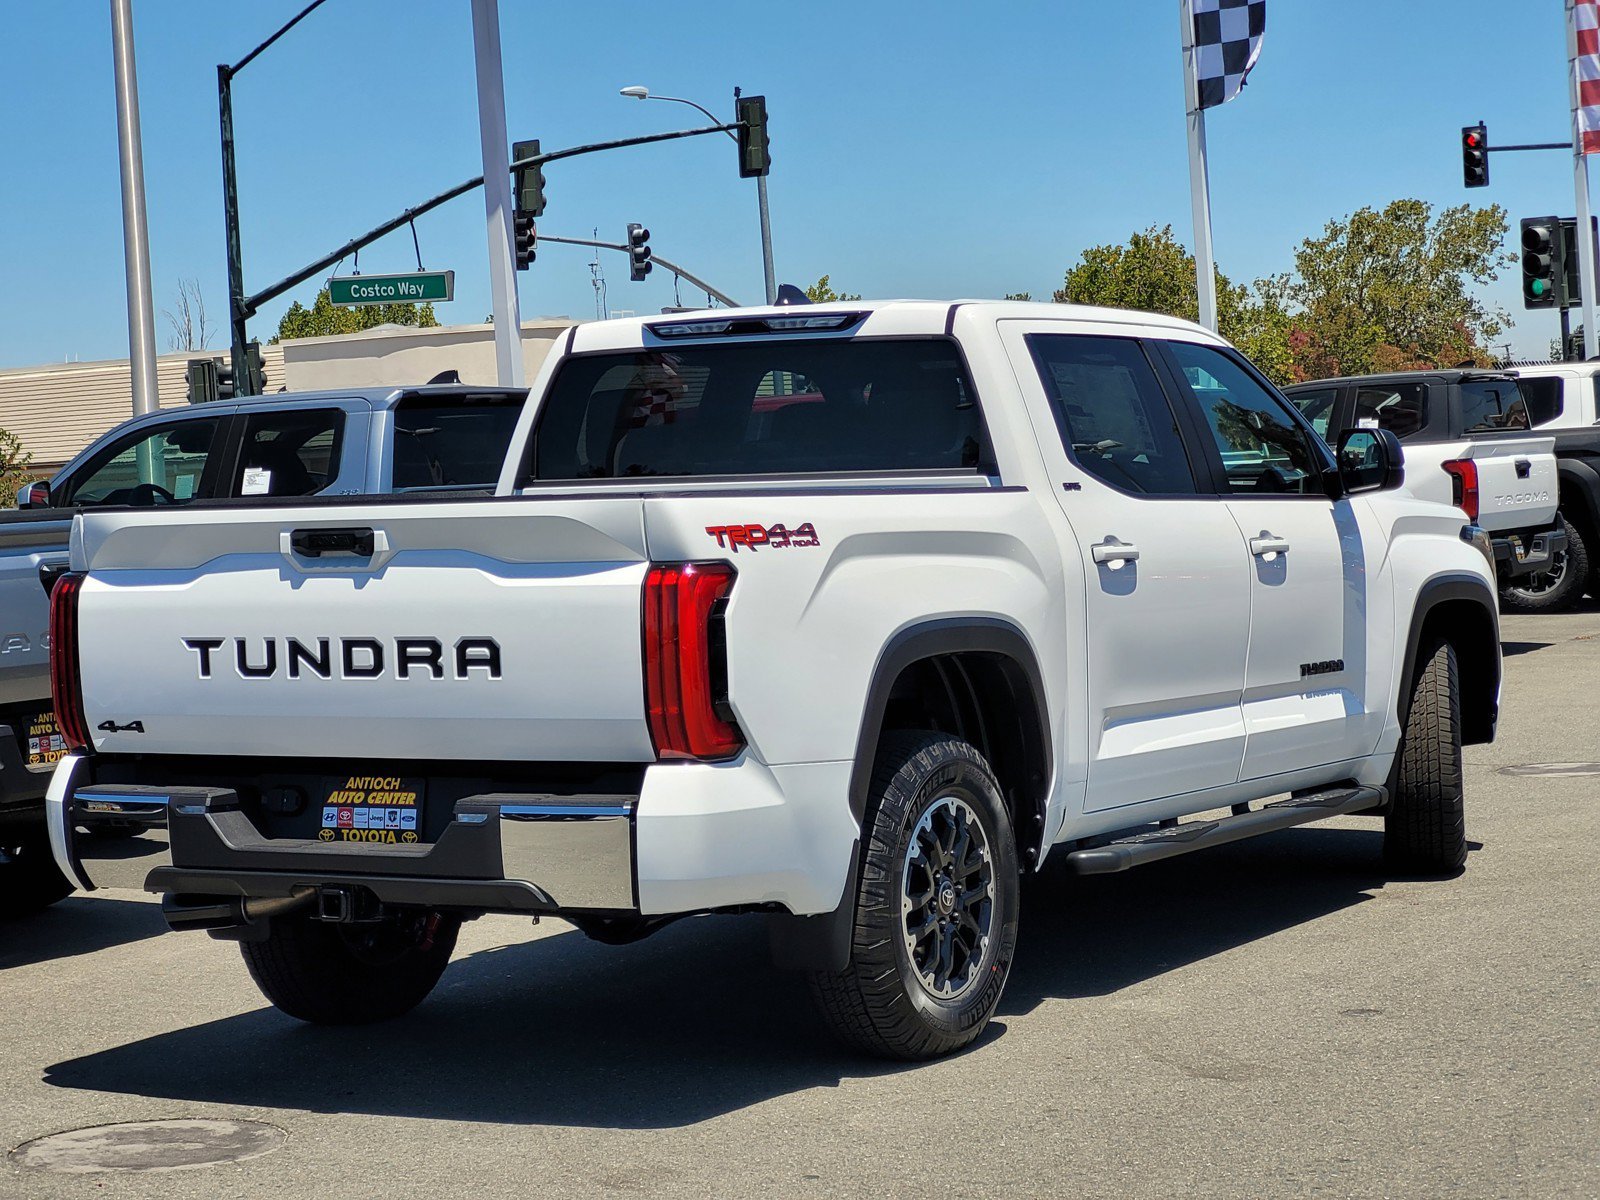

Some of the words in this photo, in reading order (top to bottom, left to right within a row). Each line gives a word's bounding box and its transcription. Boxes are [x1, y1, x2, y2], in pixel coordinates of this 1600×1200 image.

[351, 284, 394, 298] Costco
[397, 282, 424, 297] Way
[1494, 491, 1548, 506] TACOMA
[705, 524, 770, 553] TRD
[771, 540, 791, 548] OFF
[793, 539, 820, 548] ROAD
[180, 636, 502, 680] TUNDRA
[38, 712, 57, 723] ANTI
[30, 724, 52, 735] AUTO
[43, 750, 69, 763] TOYO
[345, 777, 400, 789] ANTIOCH
[327, 791, 365, 804] AUTO
[367, 791, 416, 805] CENTER
[341, 829, 396, 844] TOYOTA
